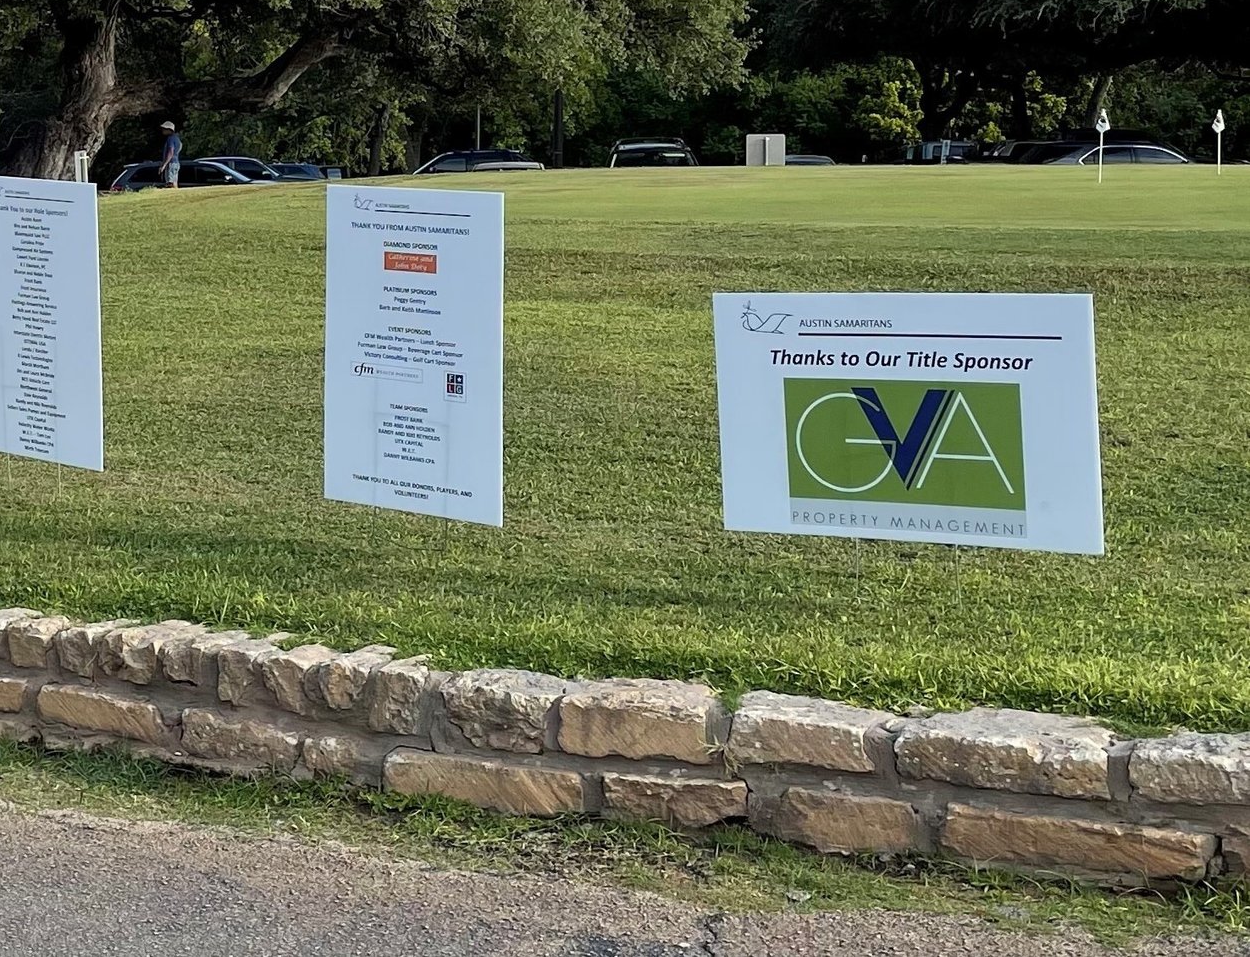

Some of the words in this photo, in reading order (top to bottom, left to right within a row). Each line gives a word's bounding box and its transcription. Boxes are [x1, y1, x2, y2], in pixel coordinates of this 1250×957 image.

[405, 225, 427, 233] AUSTIN
[428, 227, 470, 236] SAMARITANS!
[384, 241, 411, 249] DIAMOND
[412, 243, 438, 251] SPONSOR
[799, 319, 832, 329] AUSTIN
[834, 319, 892, 329] SAMARITANS
[354, 362, 374, 378] cfm
[770, 349, 835, 367] Thanks
[840, 351, 859, 367] to
[865, 351, 901, 368] Our
[907, 352, 947, 369] Title
[953, 352, 1033, 372] Sponsor
[796, 387, 1015, 494] GVA
[353, 474, 369, 482] THANK
[461, 490, 472, 498] AND
[792, 511, 879, 528] PROPERTY
[890, 516, 1025, 536] MANAGEMENT
